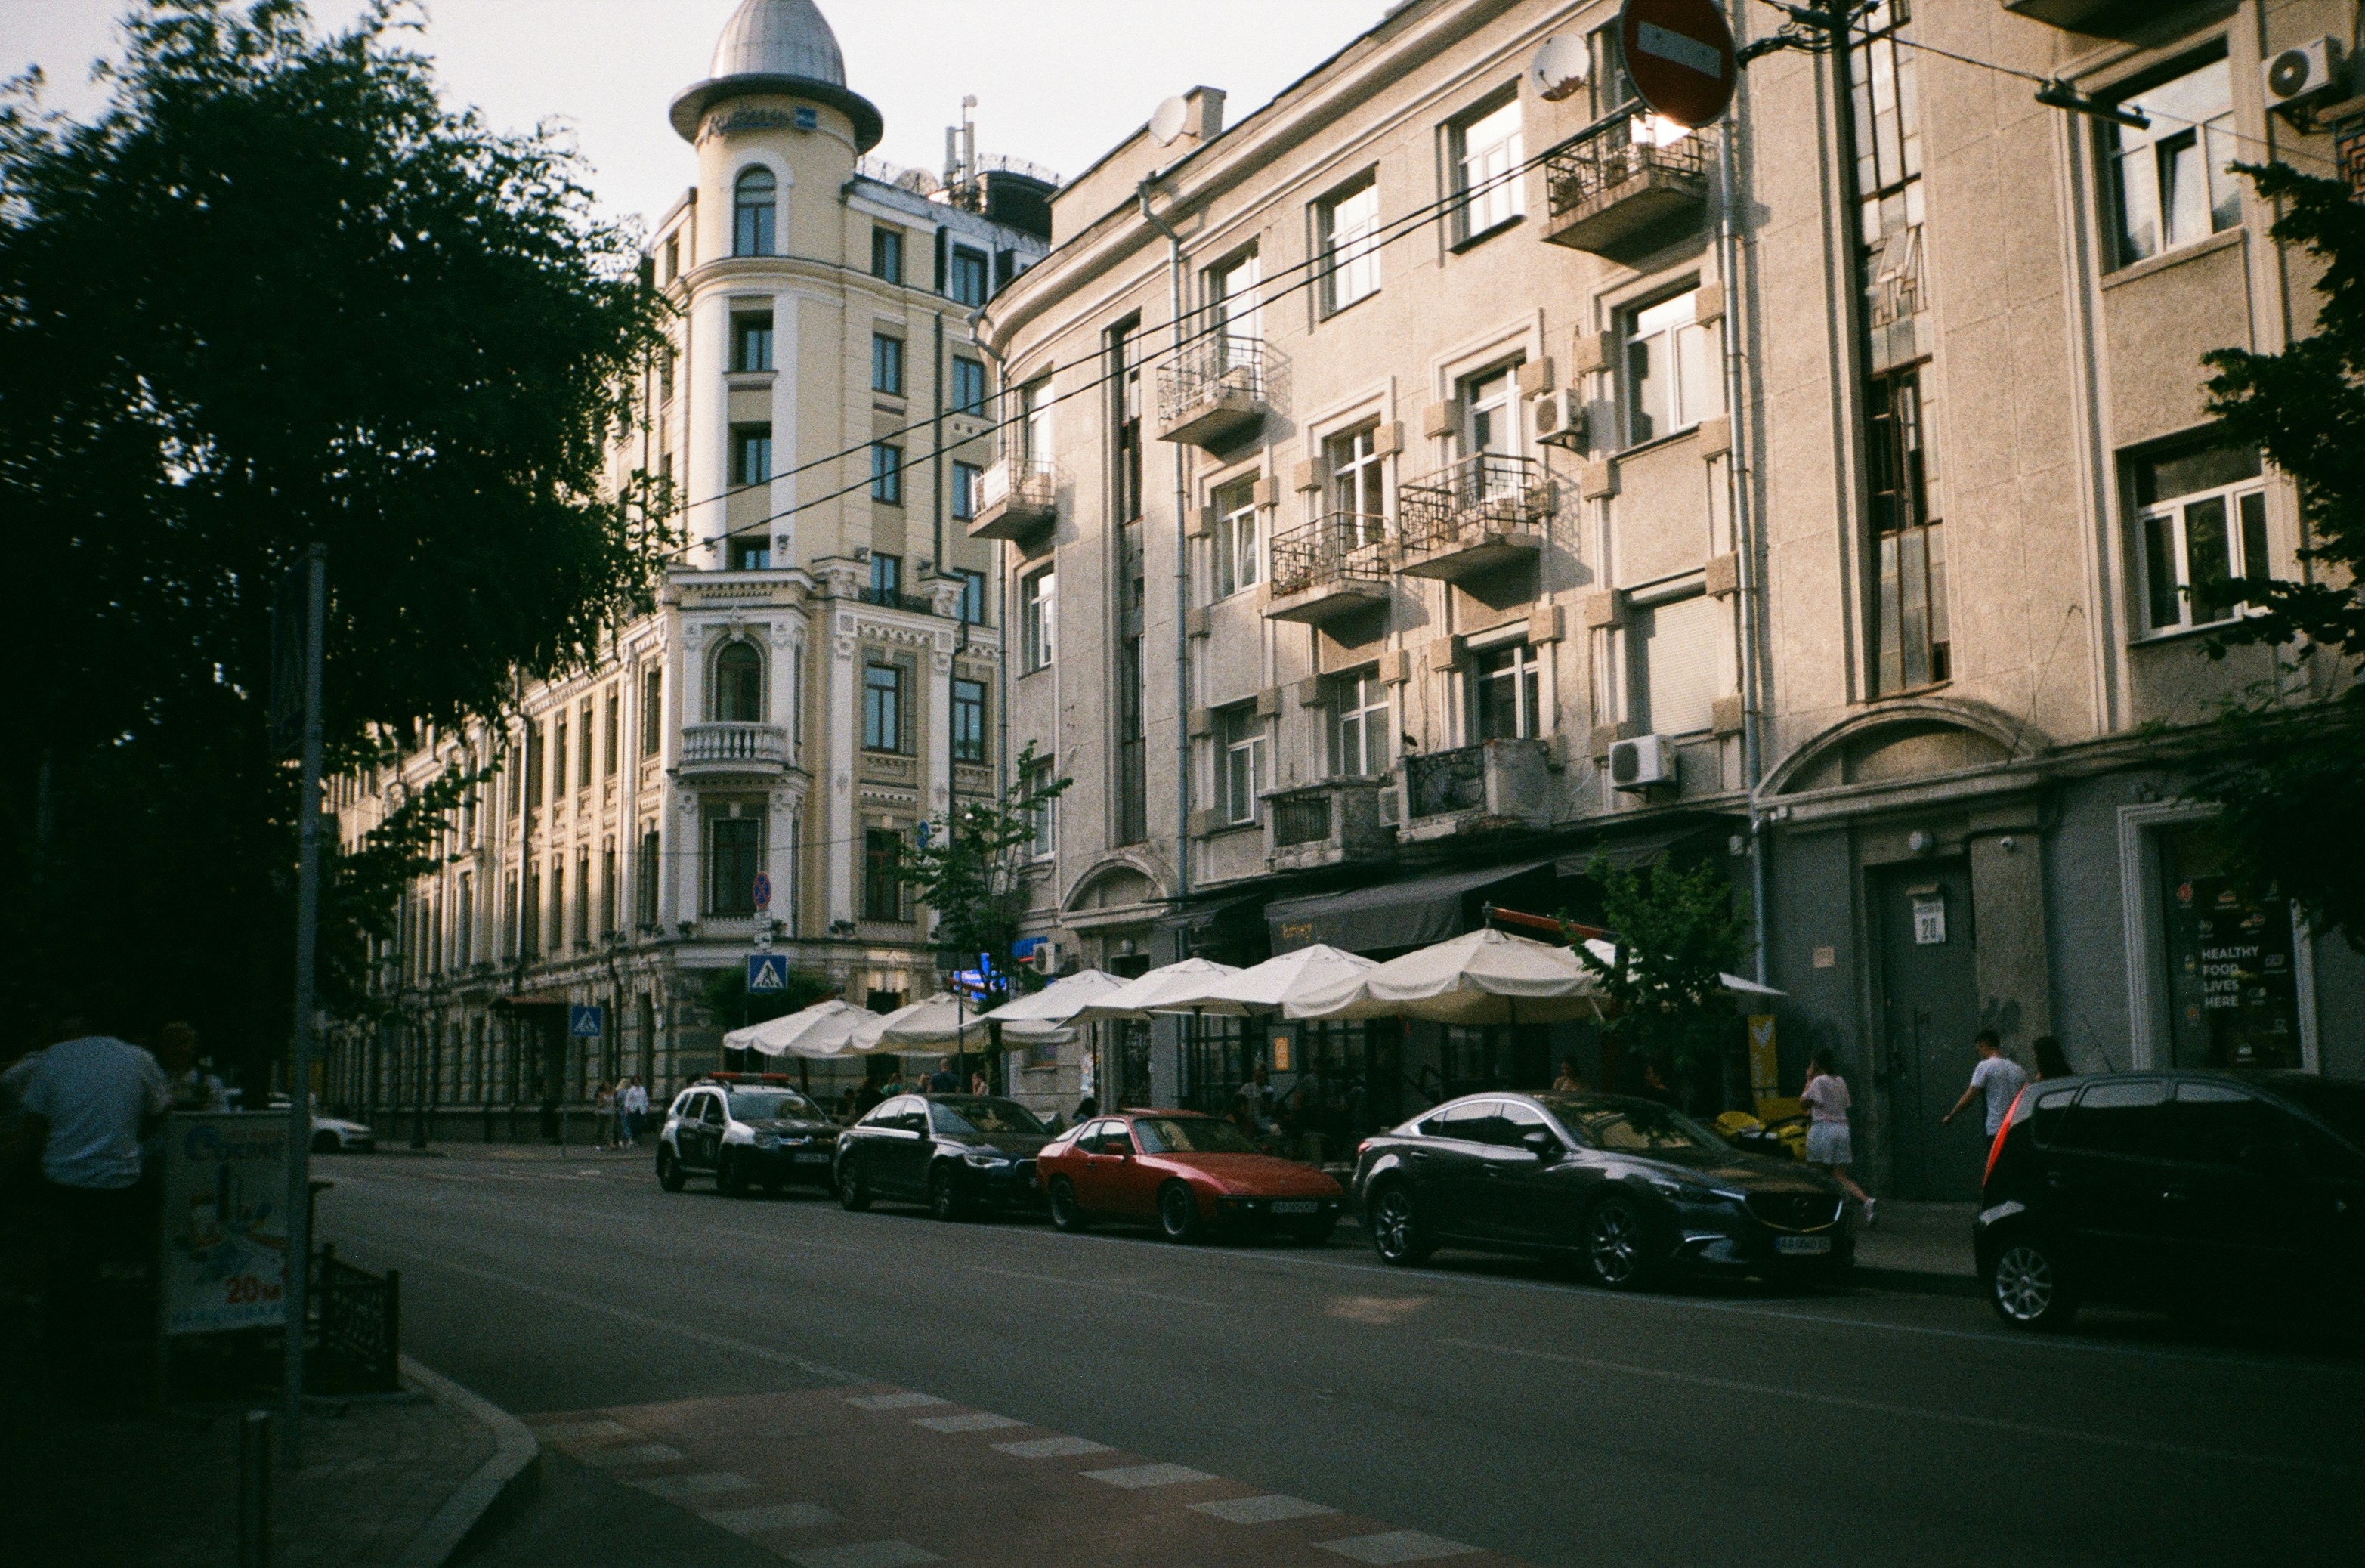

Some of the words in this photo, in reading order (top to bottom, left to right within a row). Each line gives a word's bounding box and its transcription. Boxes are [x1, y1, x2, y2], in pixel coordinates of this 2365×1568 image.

[1922, 917, 1937, 939] 20
[2202, 945, 2259, 960] HEALTHY
[2203, 963, 2240, 977] FOOD
[2203, 979, 2240, 993] LIVES
[2205, 995, 2239, 1008] HERE
